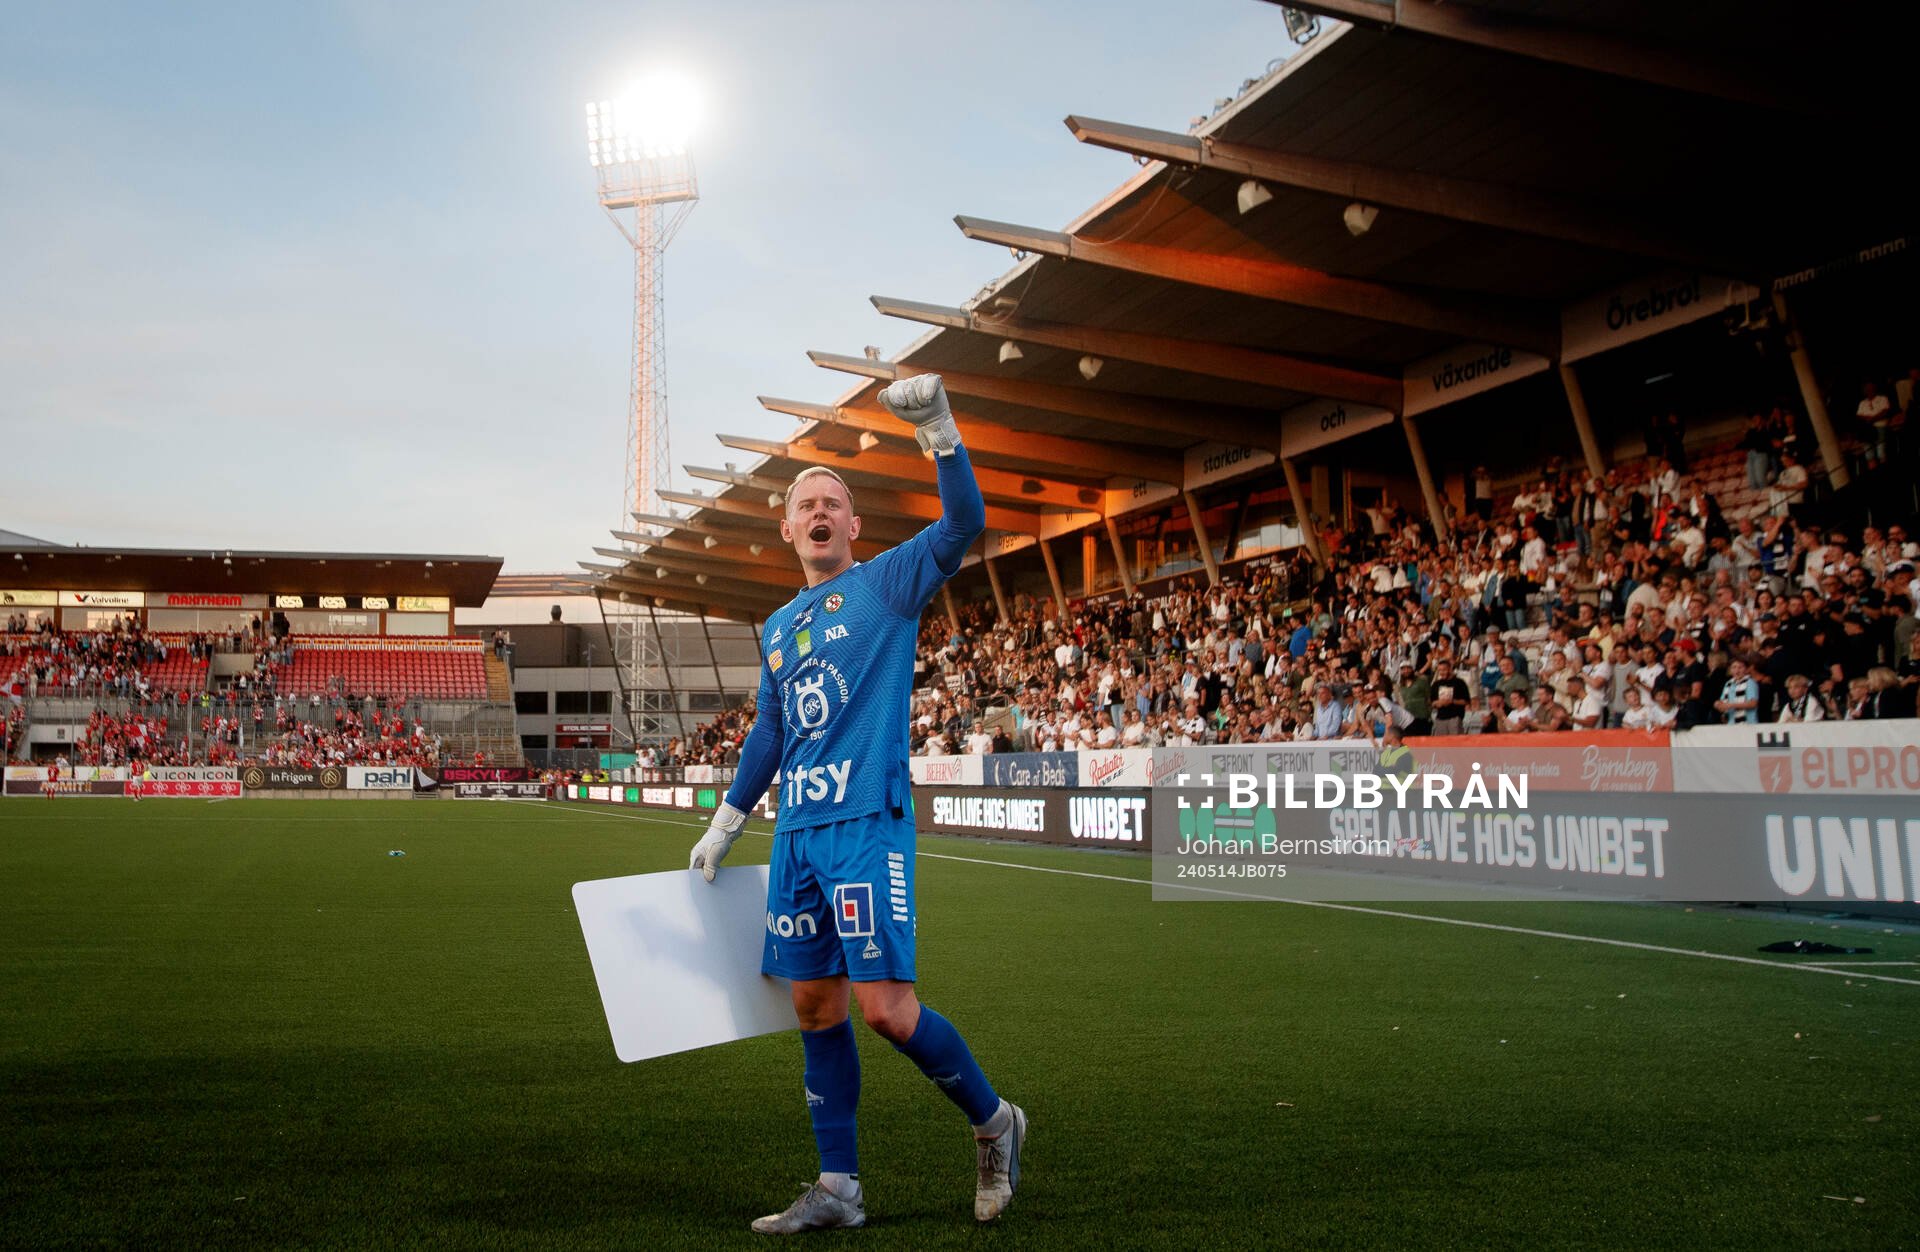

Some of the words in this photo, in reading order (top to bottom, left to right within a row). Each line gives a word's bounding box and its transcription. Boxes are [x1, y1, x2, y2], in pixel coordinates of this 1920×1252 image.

[1320, 405, 1346, 431] och
[1432, 347, 1512, 391] växande
[1606, 273, 1700, 331] Örebro!
[825, 624, 849, 642] NA
[1282, 752, 1314, 773] FRONT
[1348, 752, 1380, 772] FRON
[1580, 745, 1659, 791] Björnberg
[165, 772, 196, 780] ICON
[203, 771, 234, 780] ICON
[271, 772, 280, 781] In
[281, 771, 314, 784] Frigore
[365, 769, 411, 787] pahl
[786, 759, 852, 808] itsy
[983, 797, 1006, 829] HOS
[1006, 798, 1045, 832] UNIBET
[1069, 796, 1146, 842] UNIBET
[1409, 810, 1469, 863] LIVE
[1473, 812, 1536, 868] HOS
[1543, 814, 1669, 878] UNIBET
[1765, 814, 1920, 904] UNI
[863, 951, 882, 960] SELECT
